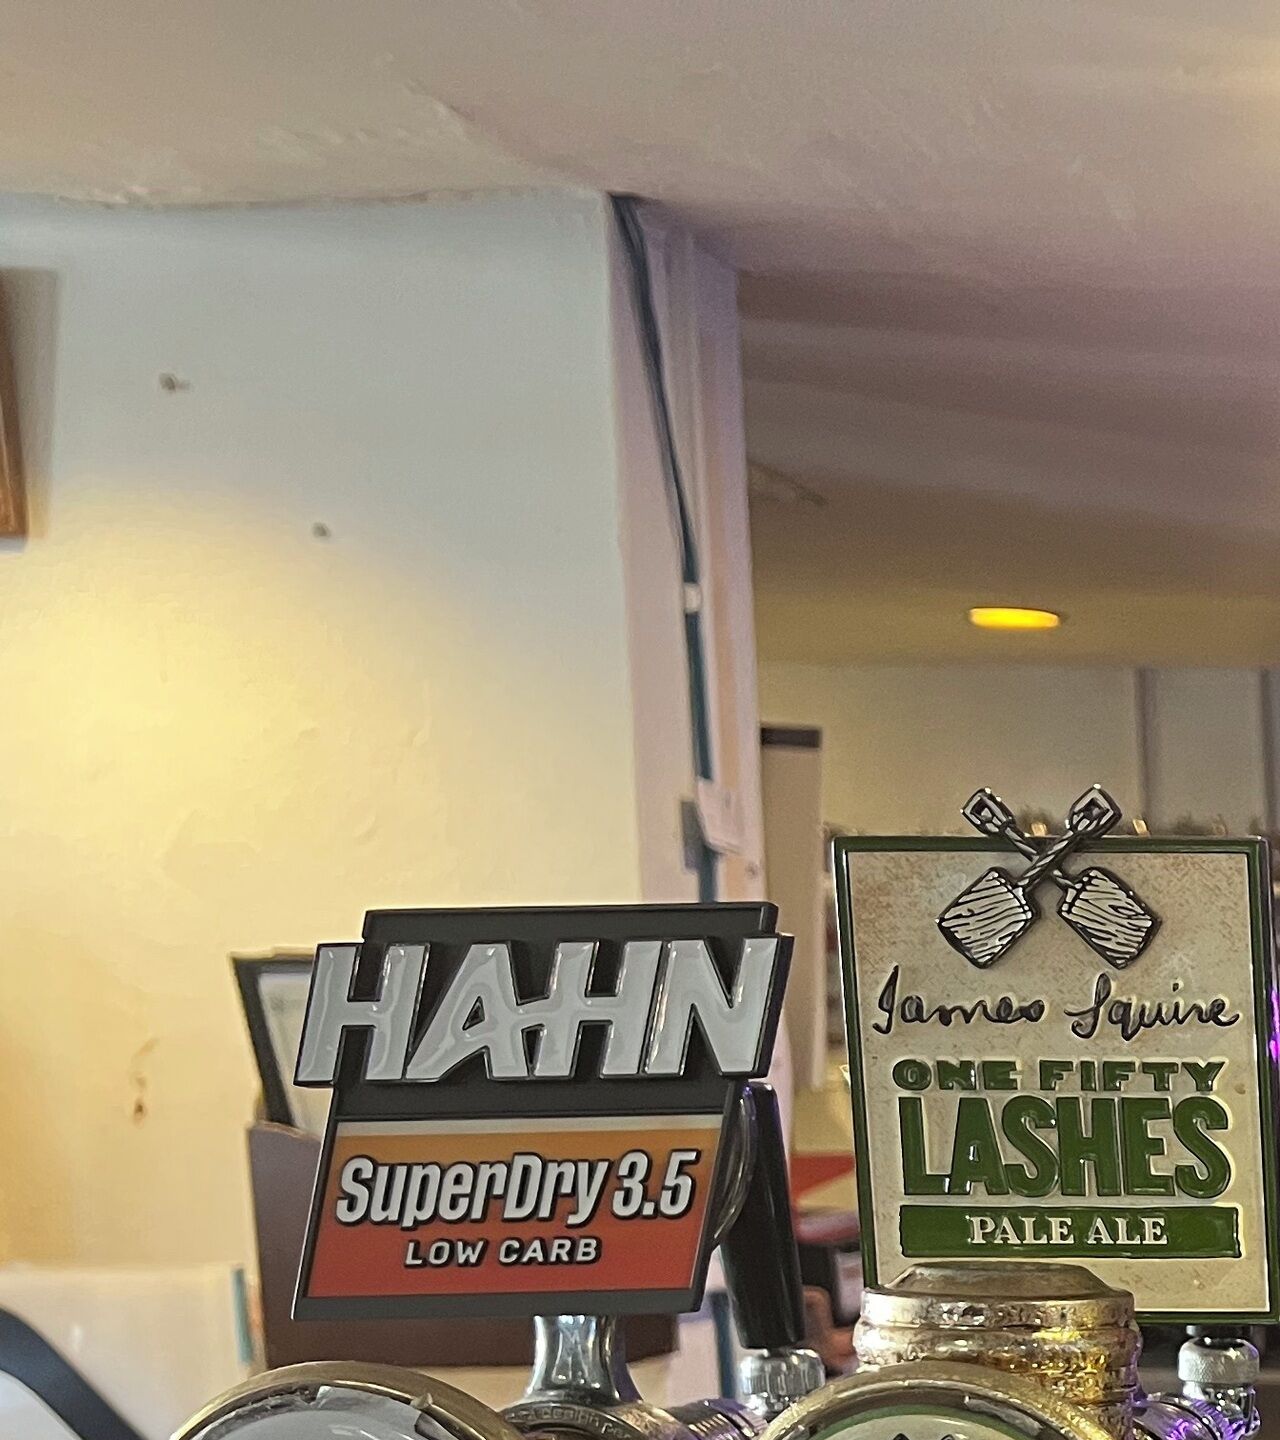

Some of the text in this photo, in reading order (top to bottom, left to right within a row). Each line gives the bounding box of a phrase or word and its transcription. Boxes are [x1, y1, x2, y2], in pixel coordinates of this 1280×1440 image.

[295, 936, 788, 1086] HAHN
[873, 964, 1241, 1043] James Squire
[891, 1058, 1227, 1094] ONE FIFTY
[898, 1095, 1231, 1199] LASHES
[335, 1149, 700, 1229] SuperDry 3.5
[405, 1235, 599, 1269] LOW CARB
[967, 1215, 1169, 1247] PALE ALE
